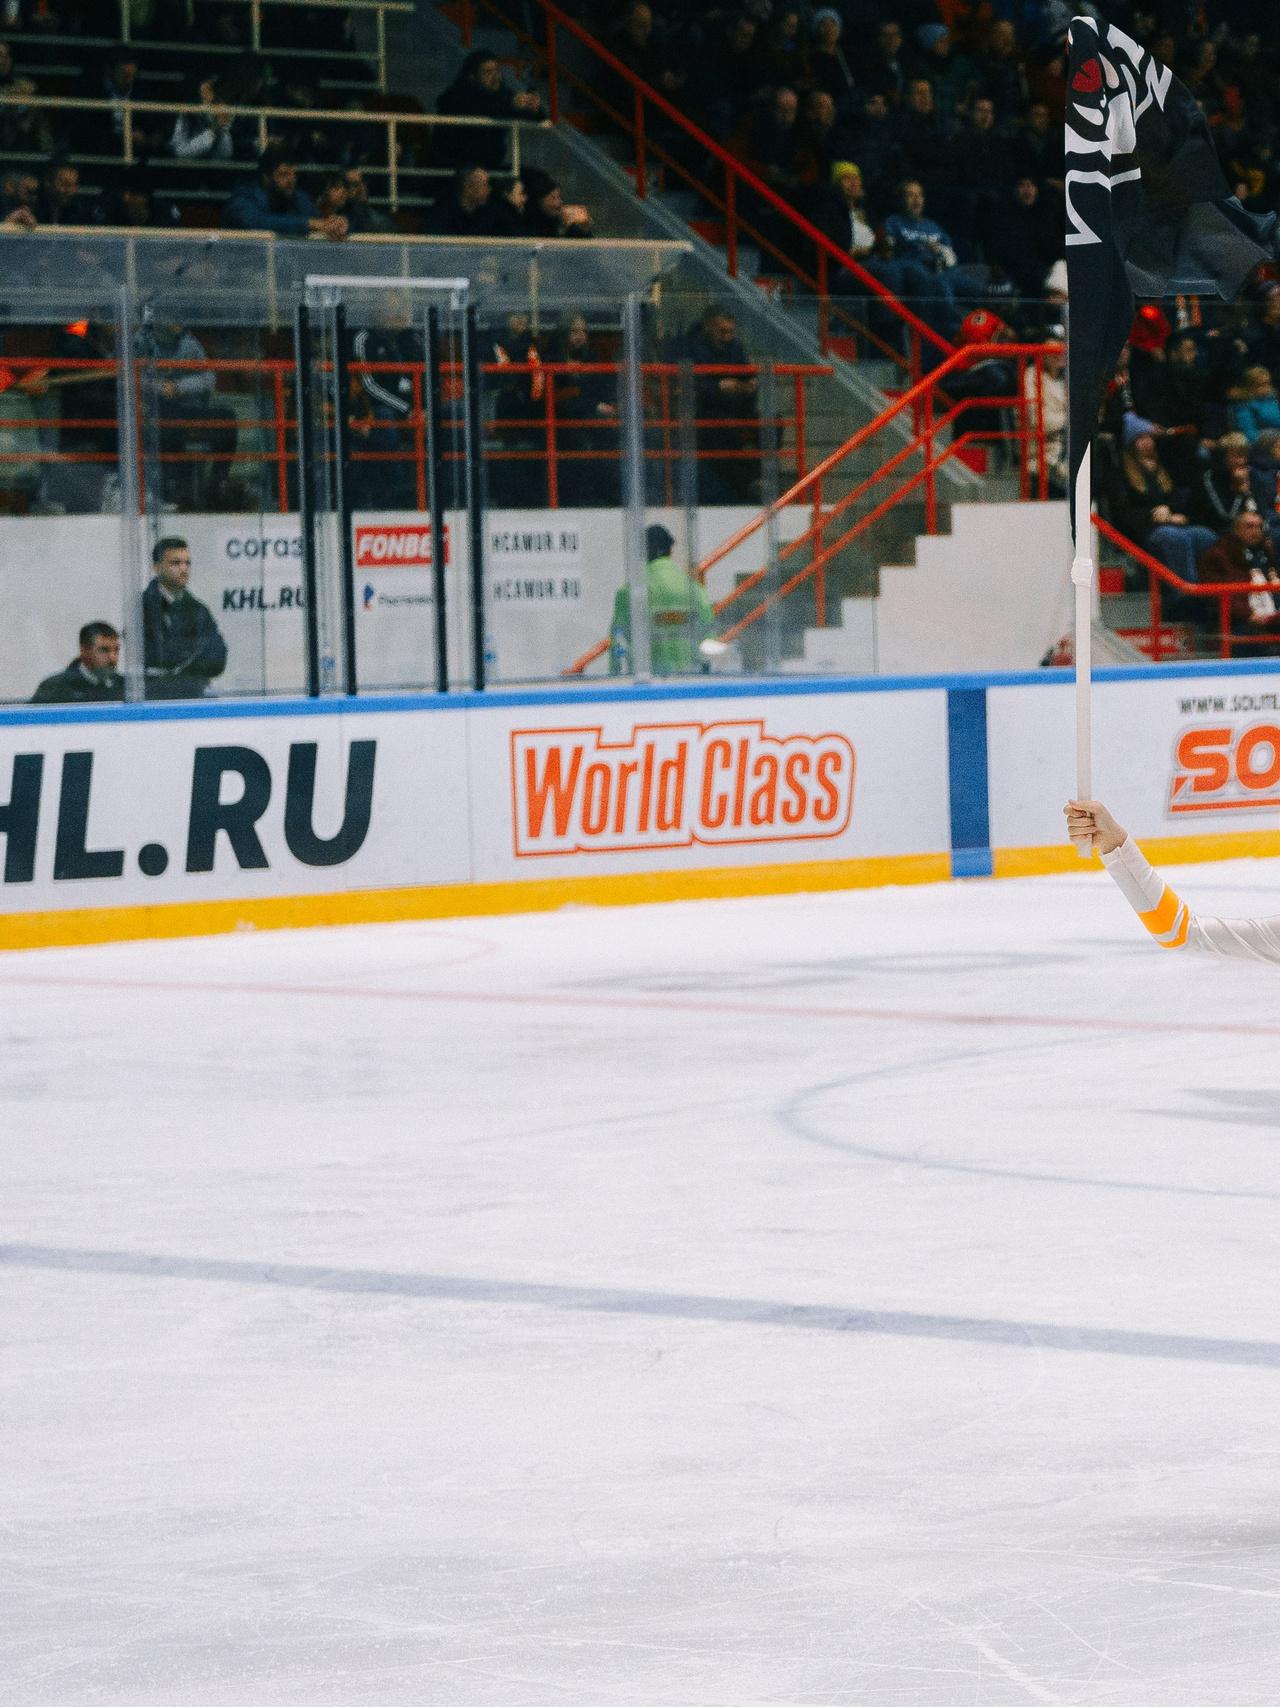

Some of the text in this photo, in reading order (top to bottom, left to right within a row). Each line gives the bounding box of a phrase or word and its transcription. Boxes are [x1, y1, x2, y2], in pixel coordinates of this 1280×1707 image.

[358, 533, 447, 559] FONBE
[524, 738, 843, 838] World Class
